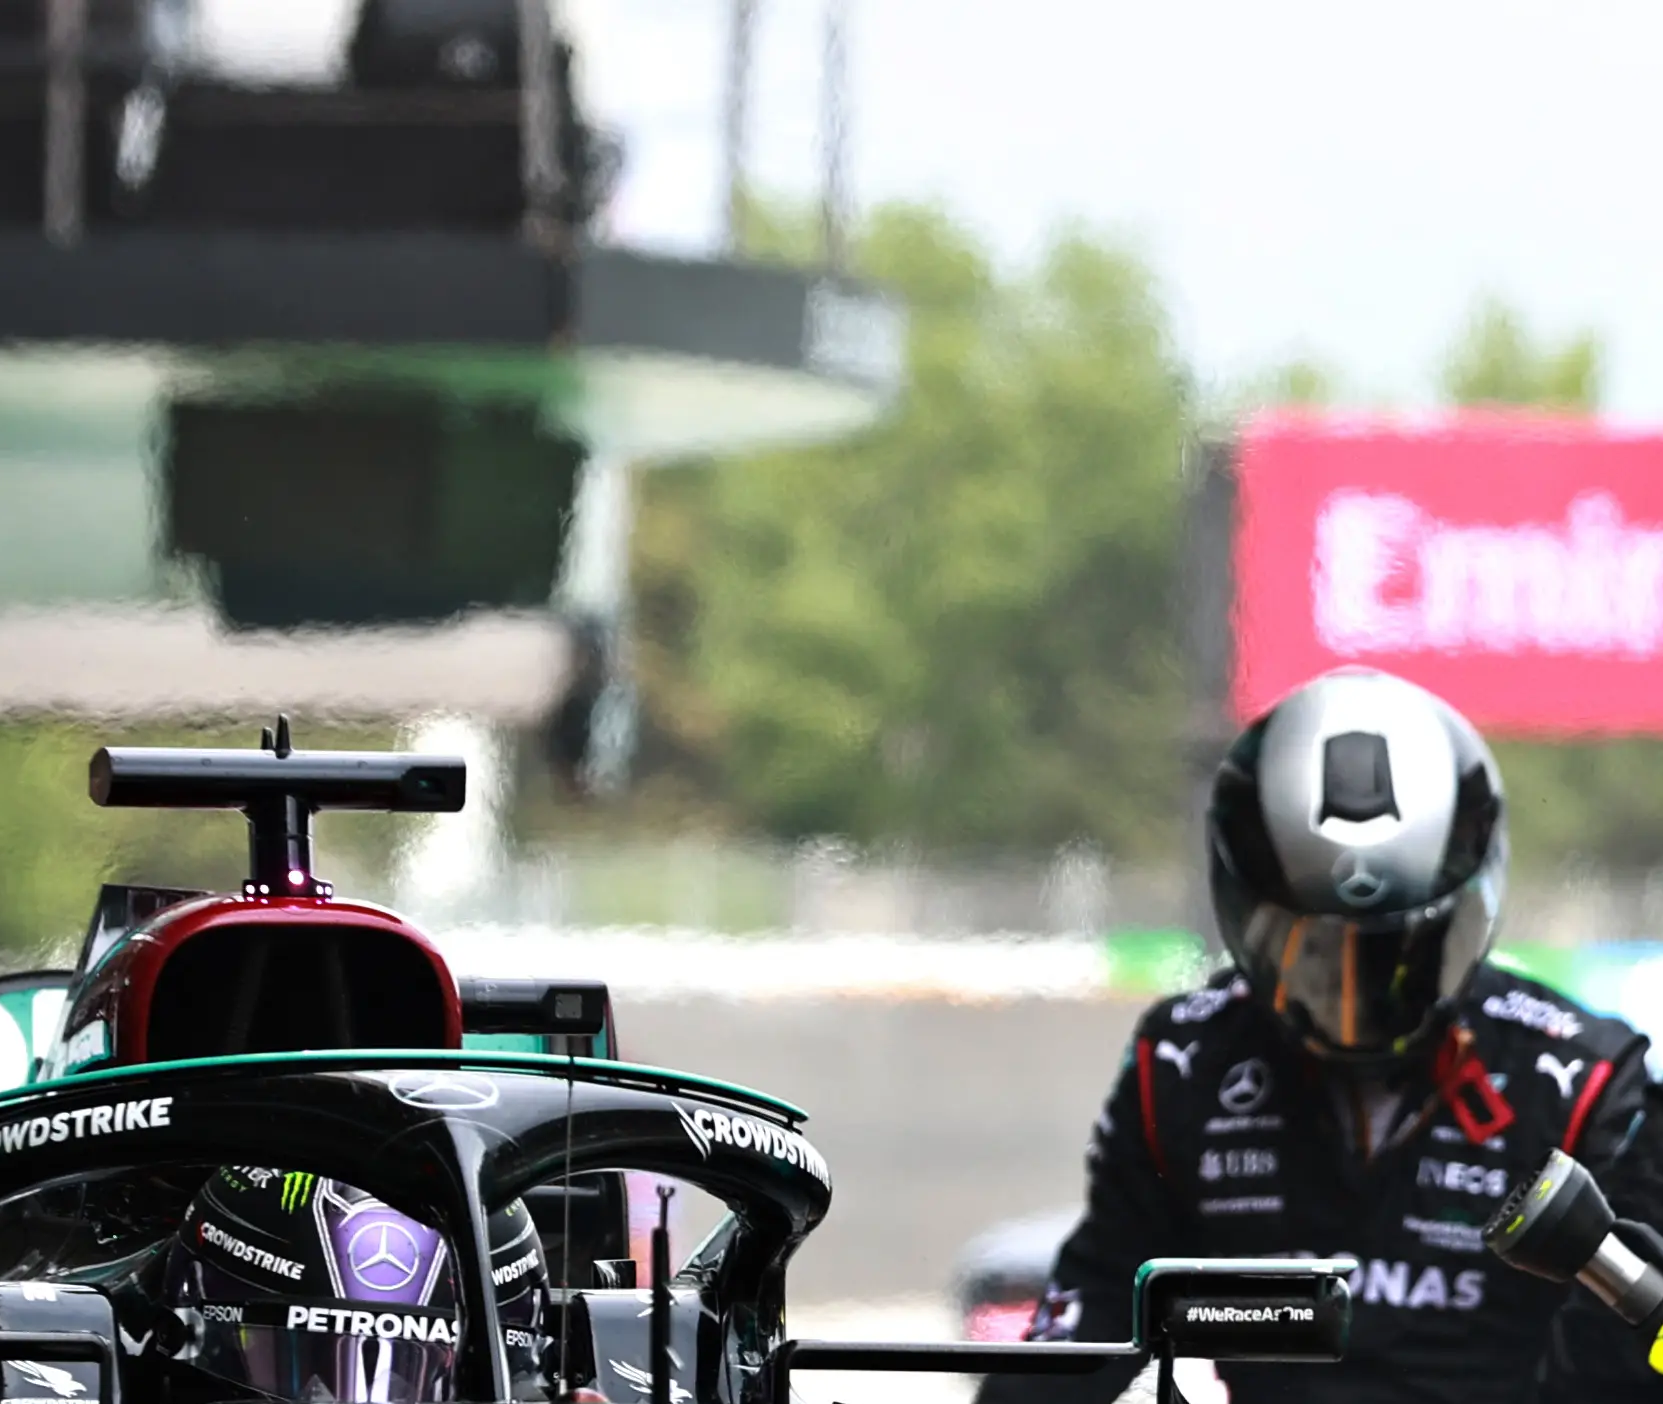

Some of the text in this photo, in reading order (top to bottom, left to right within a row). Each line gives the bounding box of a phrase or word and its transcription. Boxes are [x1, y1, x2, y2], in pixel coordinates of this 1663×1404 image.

[200, 1221, 306, 1281] CROWDSTRIKE
[1326, 1251, 1486, 1310] ONAS
[202, 1304, 245, 1323] EPSON
